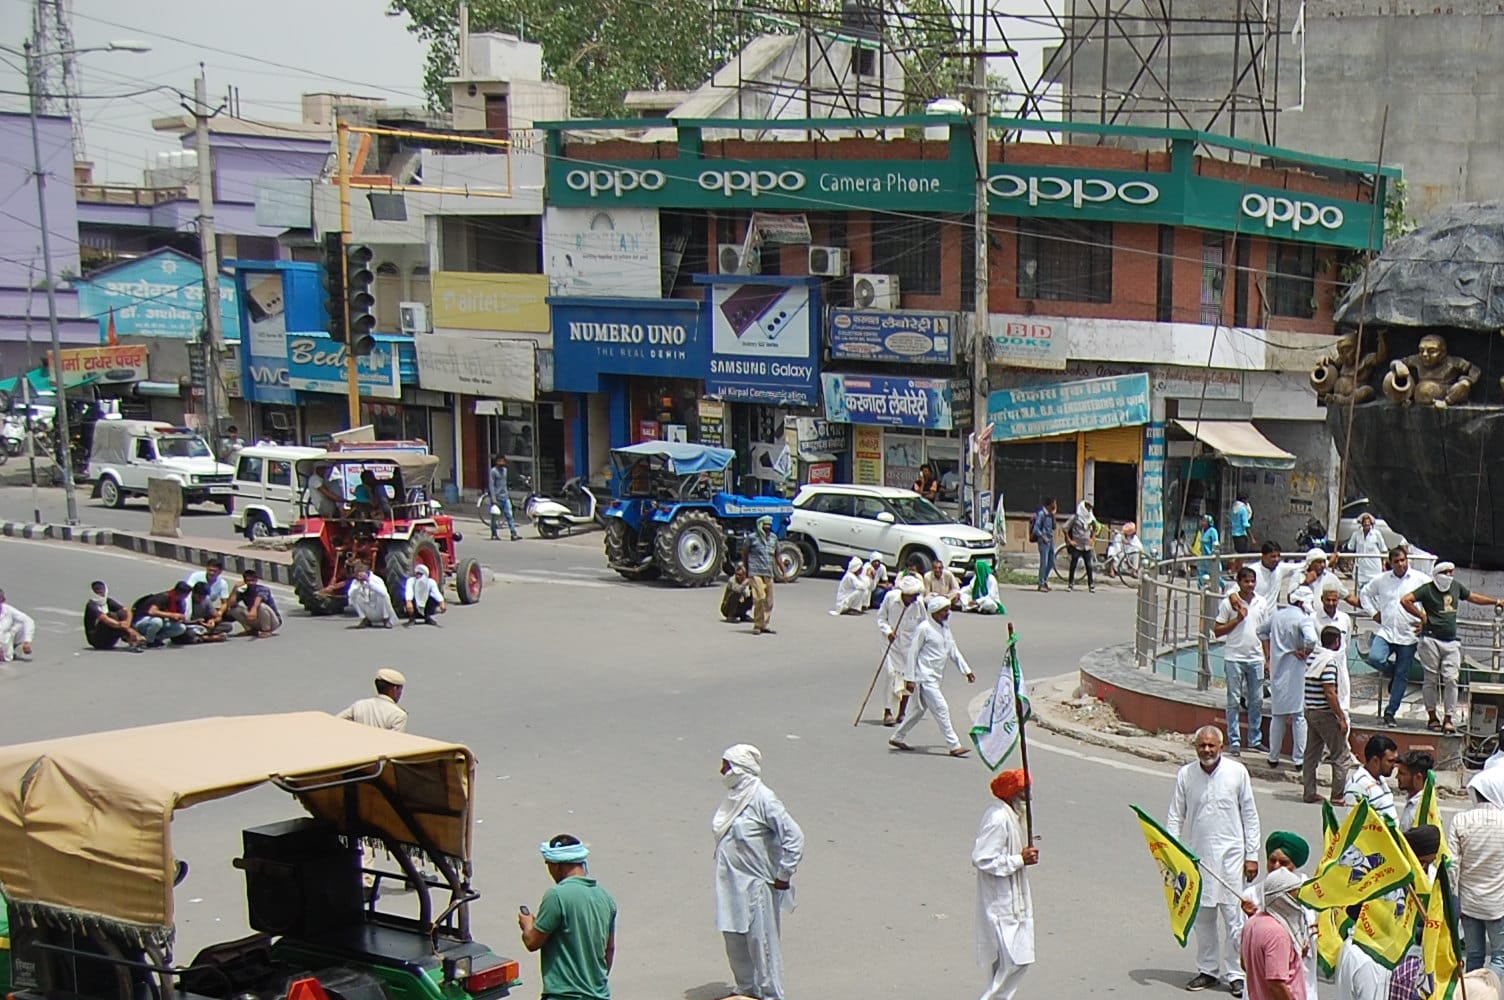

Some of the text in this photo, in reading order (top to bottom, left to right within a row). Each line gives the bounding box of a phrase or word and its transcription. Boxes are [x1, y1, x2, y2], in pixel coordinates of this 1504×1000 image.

[819, 172, 881, 192] Camera
[886, 172, 941, 193] Phone
[569, 322, 687, 345] NUMERO UNO
[650, 350, 686, 360] DENIM
[710, 360, 813, 382] SAMSUNG Galaxy
[845, 392, 887, 414] करनाल
